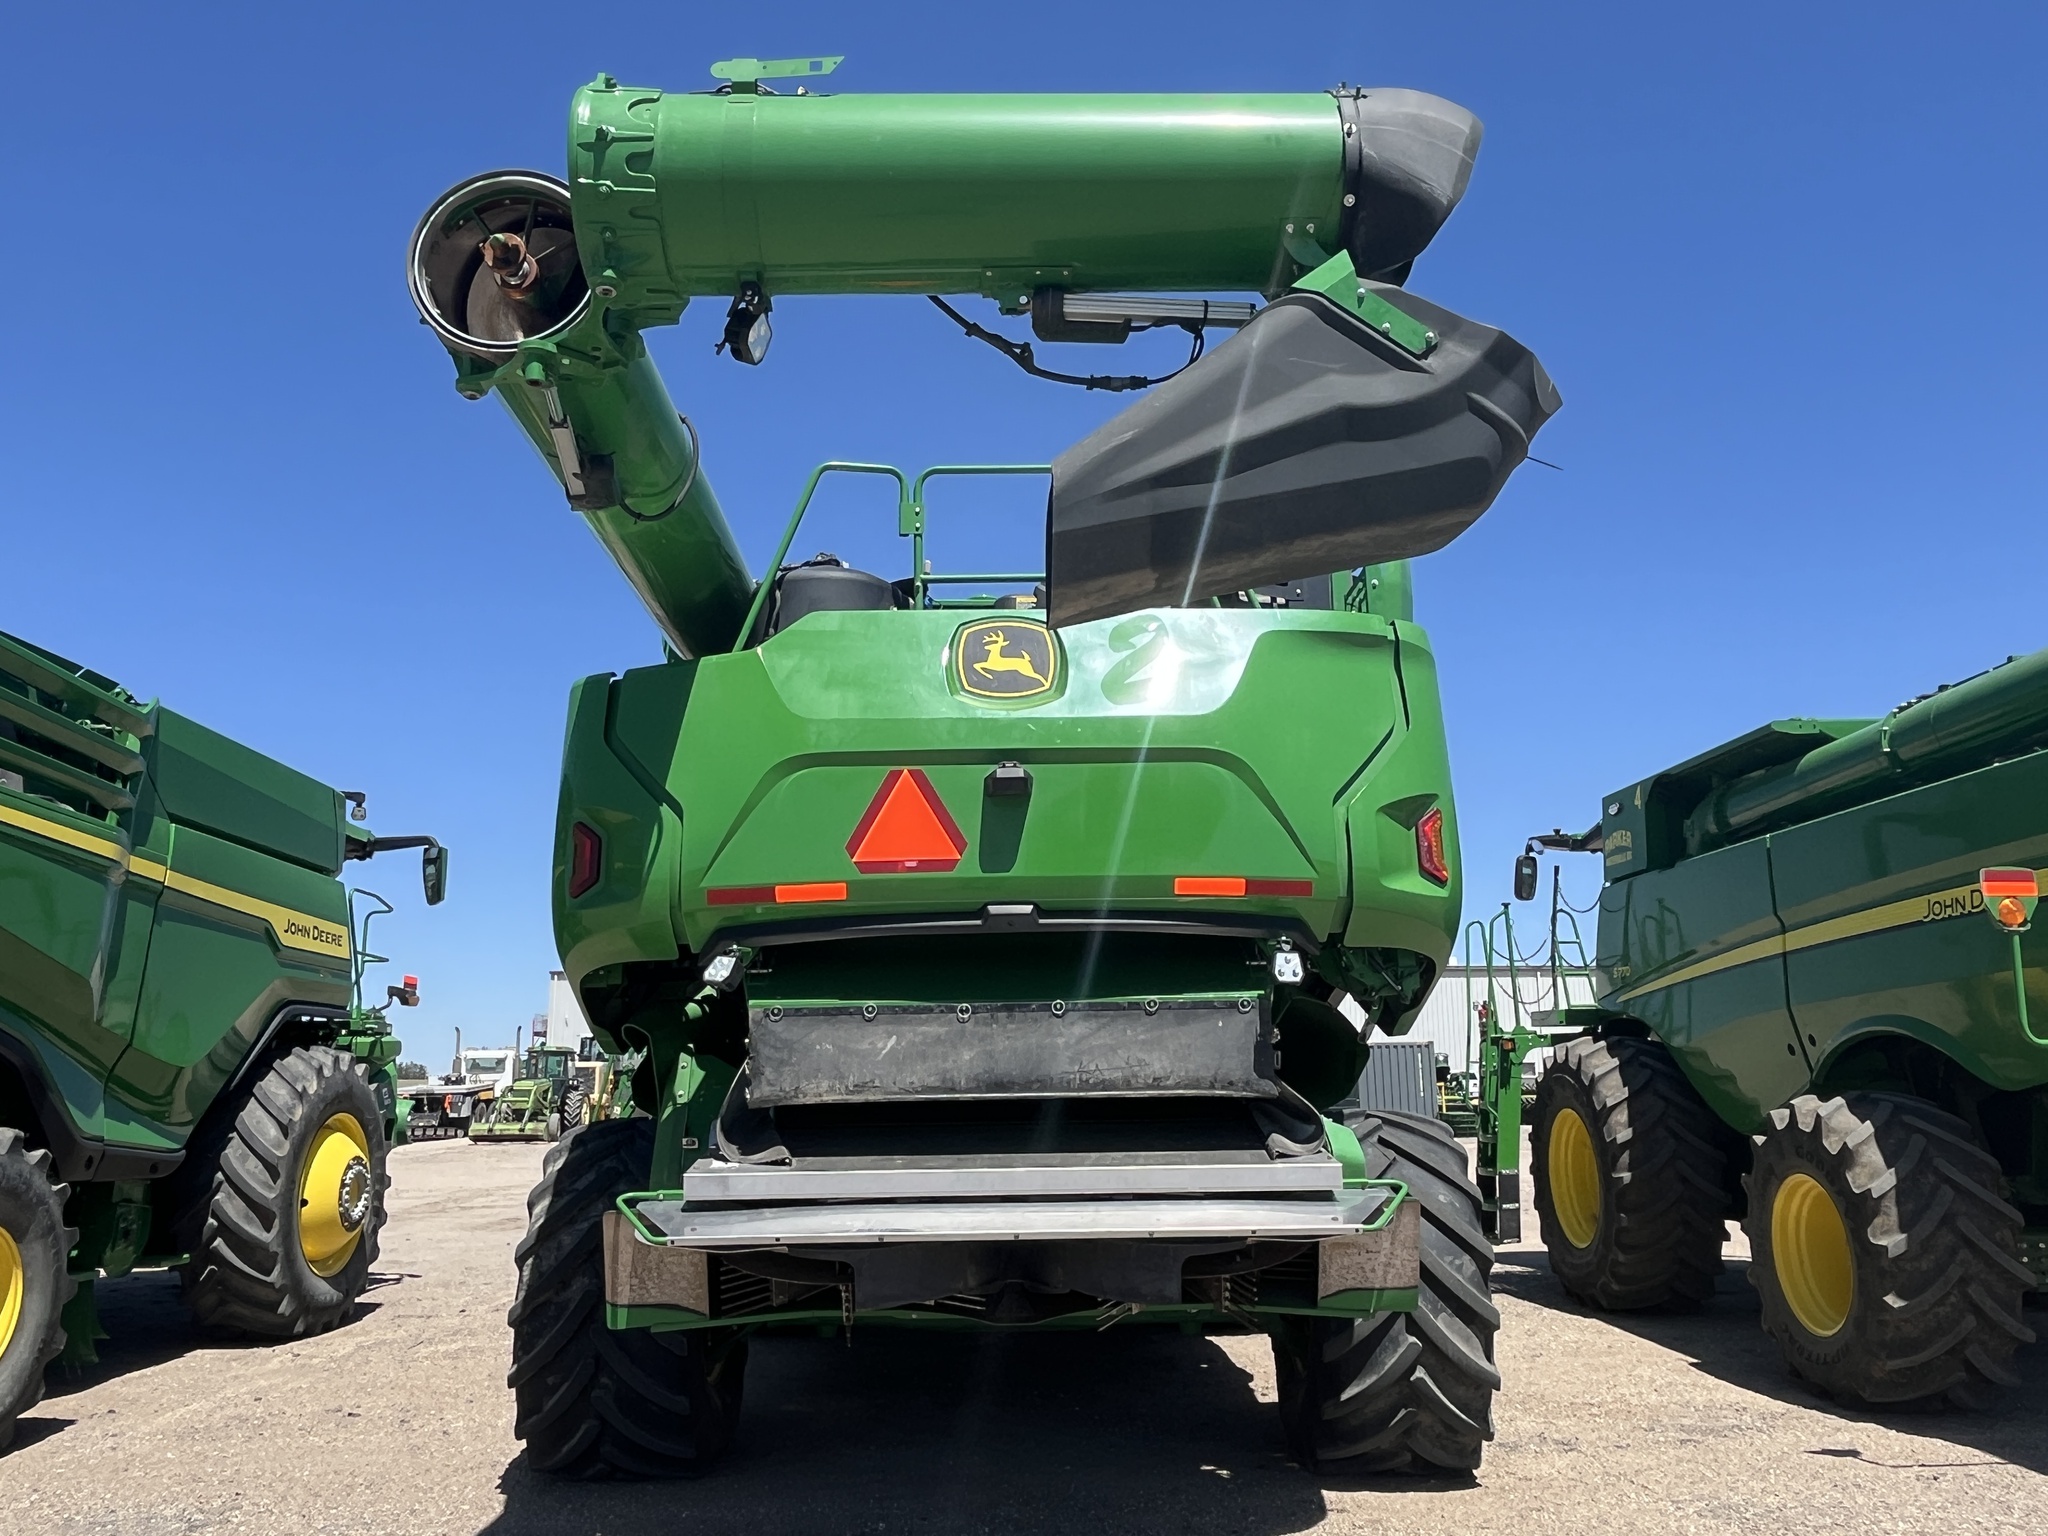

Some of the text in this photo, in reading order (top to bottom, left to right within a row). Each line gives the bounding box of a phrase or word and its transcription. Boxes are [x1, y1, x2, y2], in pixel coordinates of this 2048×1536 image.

[1634, 784, 1642, 810] 4
[1923, 895, 1966, 919] JOHN
[284, 918, 343, 948] JOHN DEERE
